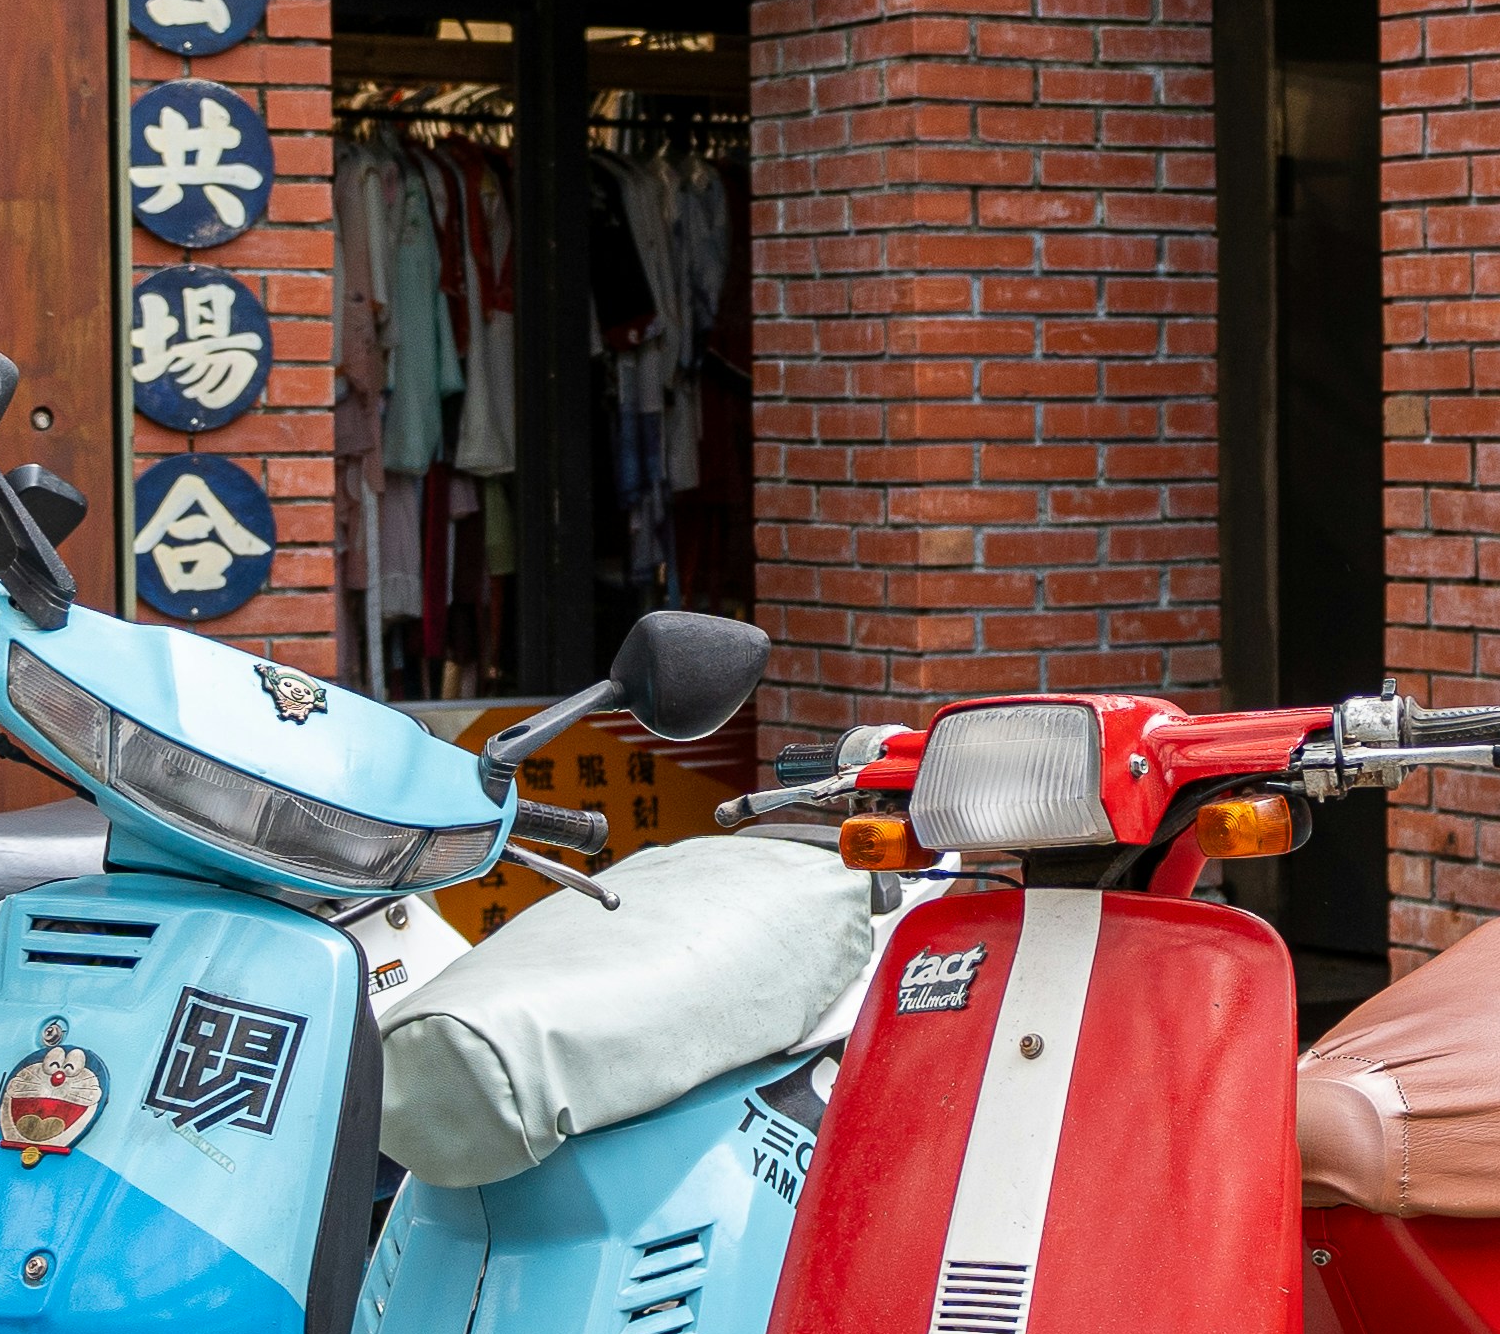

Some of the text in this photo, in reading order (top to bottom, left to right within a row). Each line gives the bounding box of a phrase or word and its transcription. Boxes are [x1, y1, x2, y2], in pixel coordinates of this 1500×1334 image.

[900, 942, 985, 987] tact
[897, 982, 968, 1012] Fullmark
[738, 1097, 816, 1175] TEC
[752, 1147, 800, 1210] YAM
